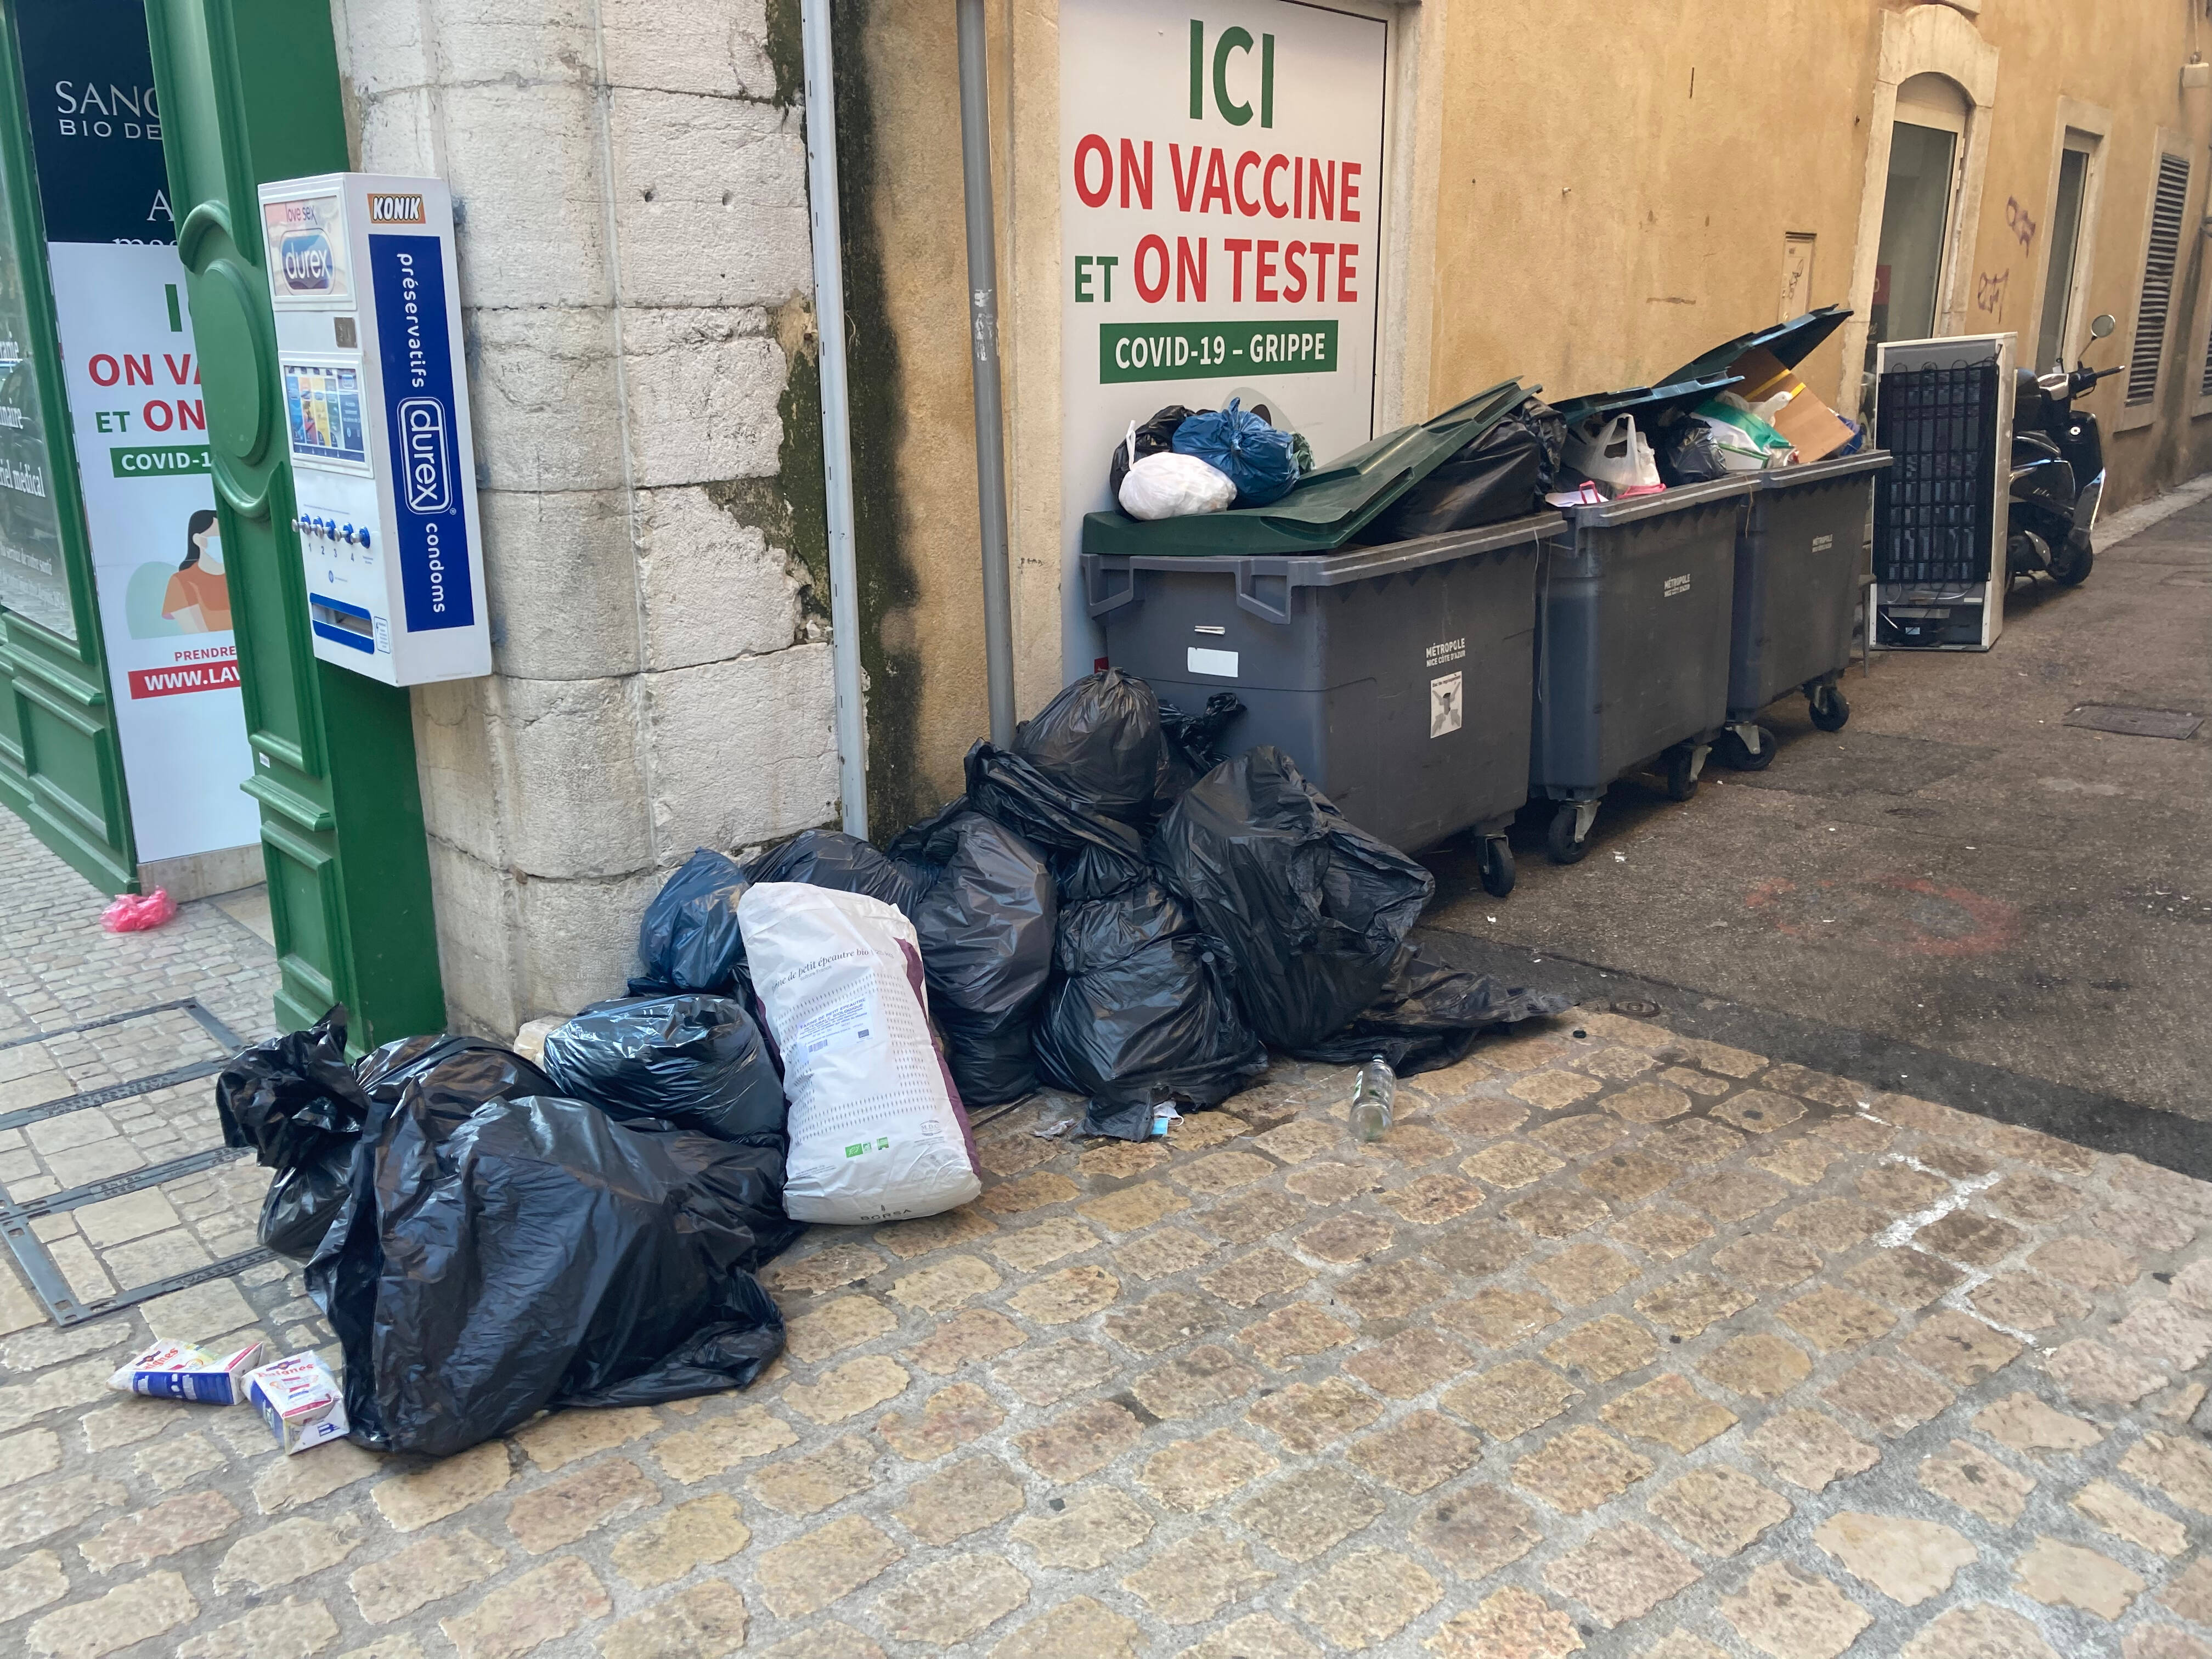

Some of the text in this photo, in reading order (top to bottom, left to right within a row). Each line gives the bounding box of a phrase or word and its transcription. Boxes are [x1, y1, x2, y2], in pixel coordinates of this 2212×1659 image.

[1190, 19, 1274, 129] ICI
[59, 119, 163, 140] BIO DE
[1074, 134, 1361, 223] ON VACCINE
[373, 196, 421, 221] KONIK
[285, 241, 330, 279] durex
[1075, 234, 1358, 303] ET ON TESTE
[397, 253, 427, 388] préservatifs
[1115, 335, 1225, 369] COVID-19
[1250, 333, 1325, 363] GRIPPE
[88, 354, 154, 387] ON
[95, 400, 206, 433] ET ON
[410, 409, 440, 501] durex
[13, 461, 46, 498] médical
[321, 546, 325, 555] 2
[334, 549, 337, 558] 3
[351, 553, 354, 562] 4
[425, 522, 445, 613] condoms
[174, 646, 236, 662] PRENDRE
[1426, 637, 1466, 658] MÉTROPOLE
[1426, 650, 1466, 667] NICE CÔTE D'AZUR
[788, 971, 797, 981] de
[799, 961, 816, 978] petit
[818, 951, 855, 967] épeautre
[860, 1209, 912, 1221] BORSA
